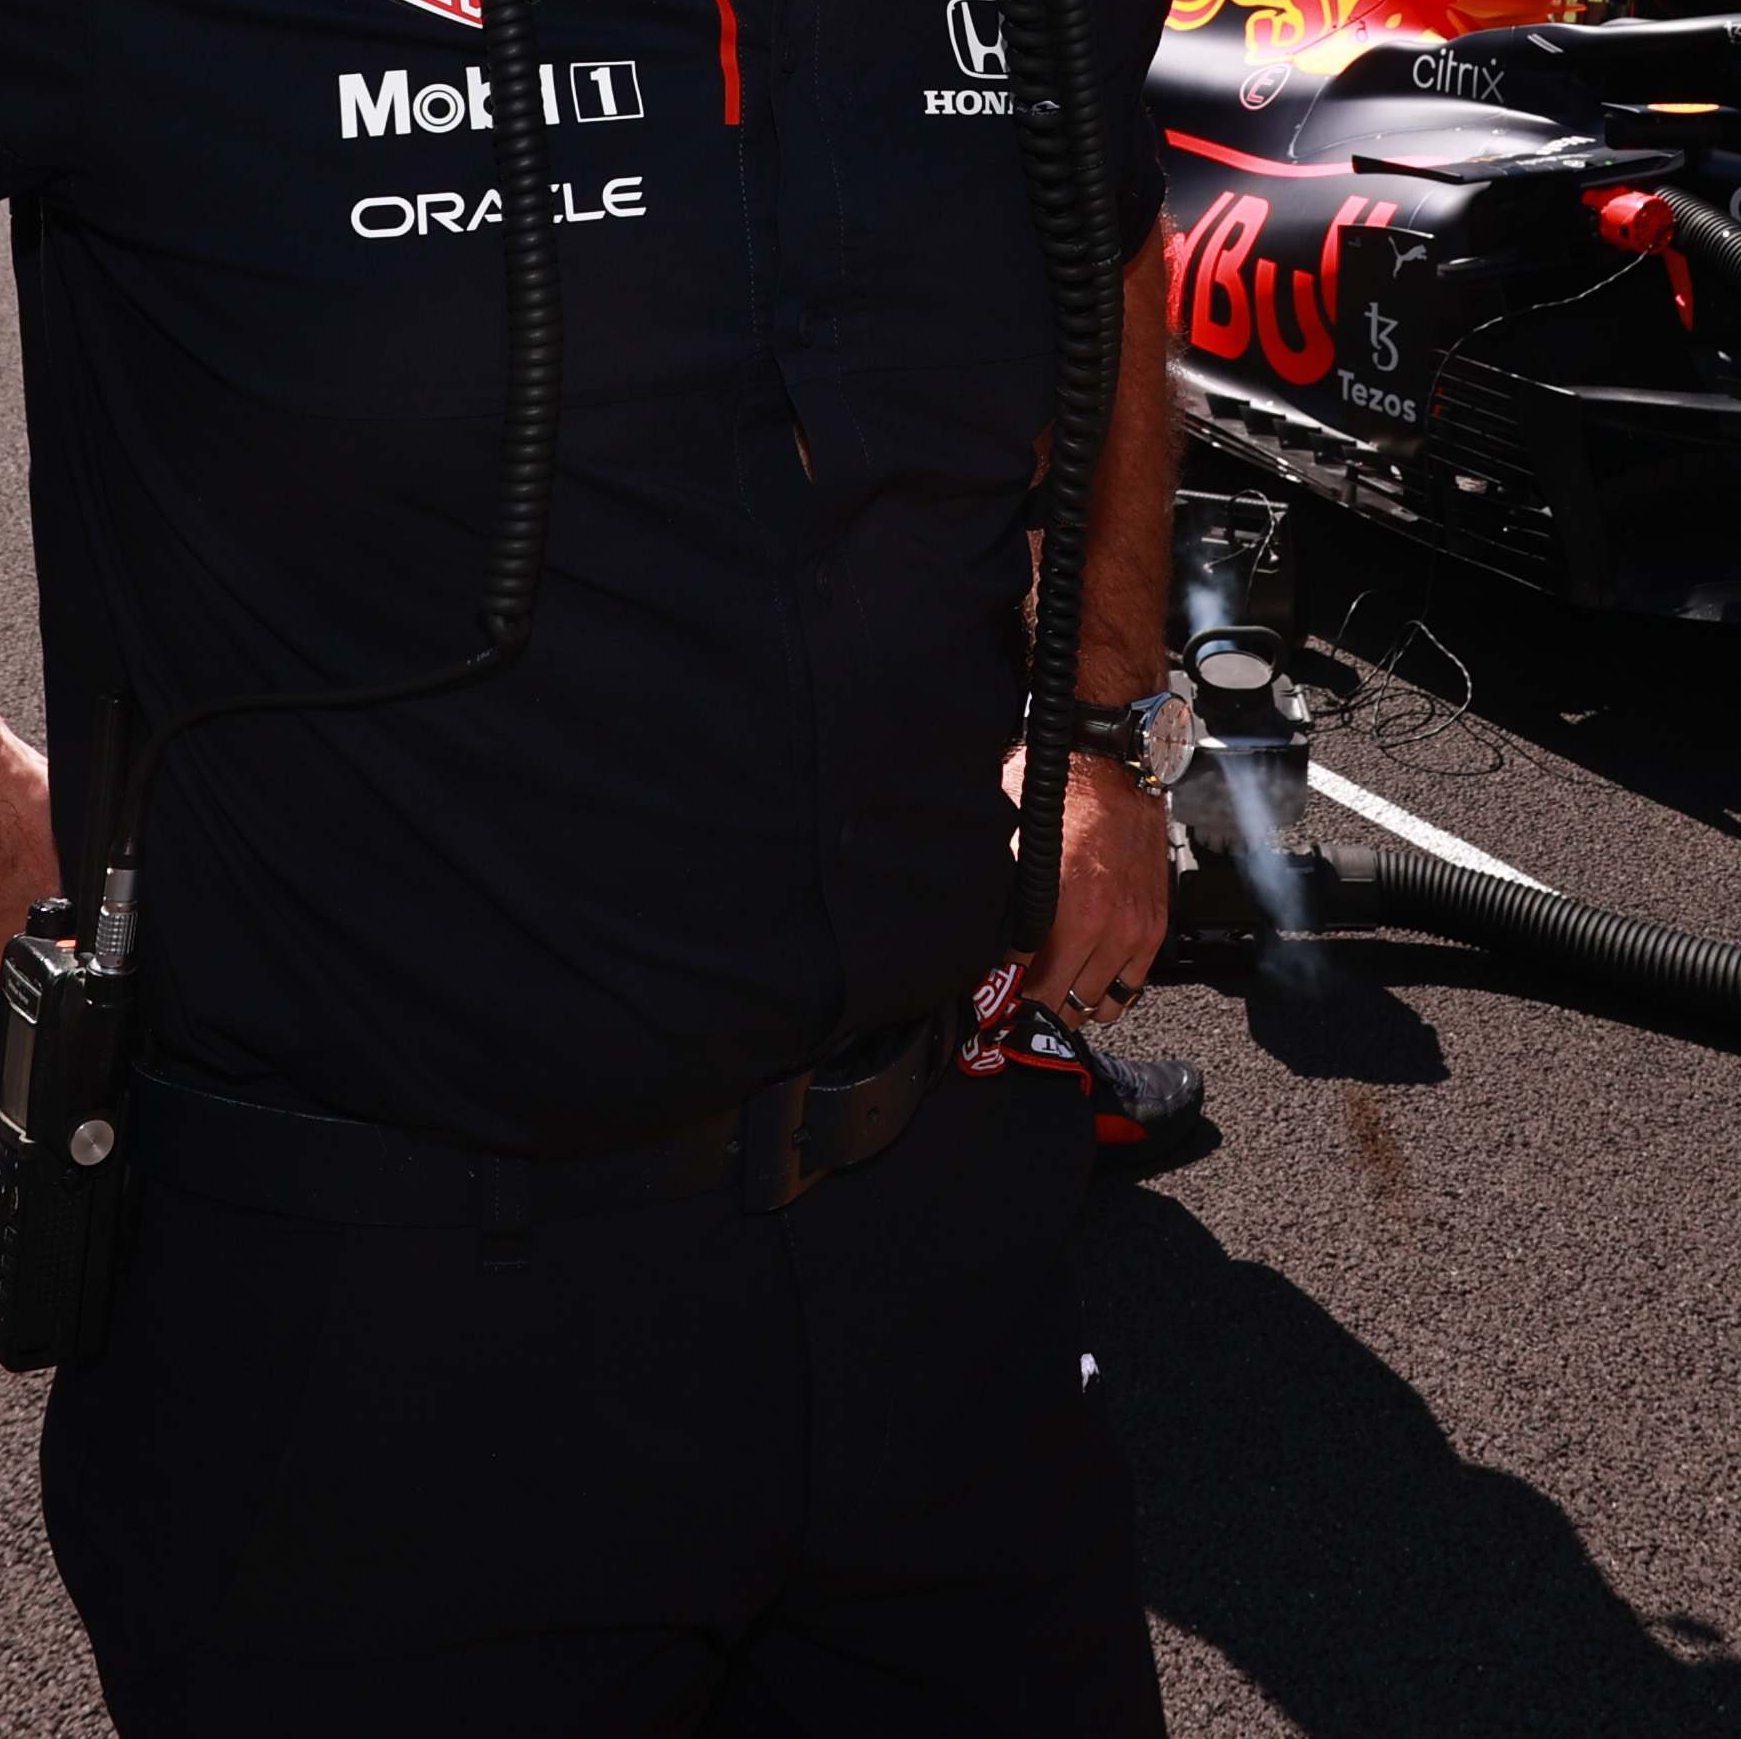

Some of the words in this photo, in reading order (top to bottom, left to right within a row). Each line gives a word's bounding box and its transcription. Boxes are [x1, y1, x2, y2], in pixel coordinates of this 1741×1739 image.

[339, 64, 560, 139] Mobl
[590, 67, 618, 116] 1
[1412, 48, 1506, 104] citrix
[351, 176, 647, 239] ORALE
[1337, 369, 1417, 423] Tezos
